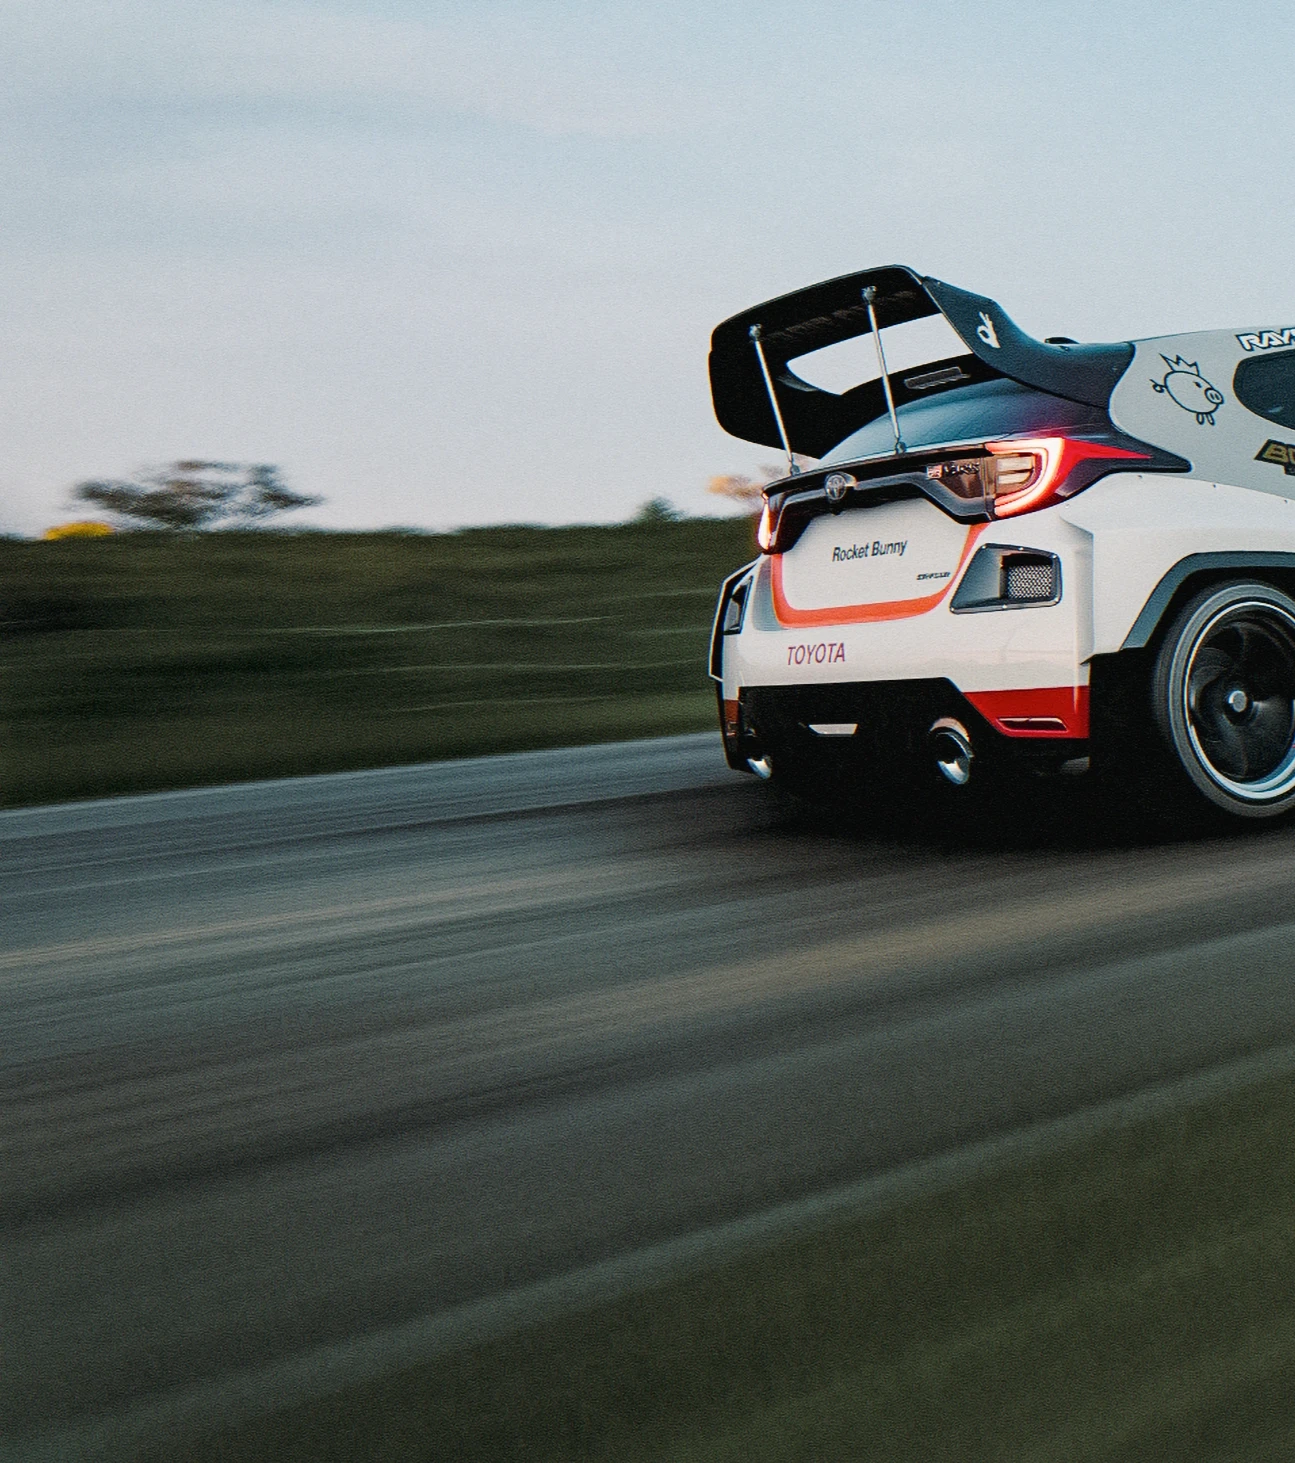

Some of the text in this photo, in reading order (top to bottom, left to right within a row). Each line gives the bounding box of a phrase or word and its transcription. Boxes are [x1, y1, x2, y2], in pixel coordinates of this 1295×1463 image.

[832, 540, 908, 562] Rocket Bunny
[787, 642, 846, 666] TOYOTA
